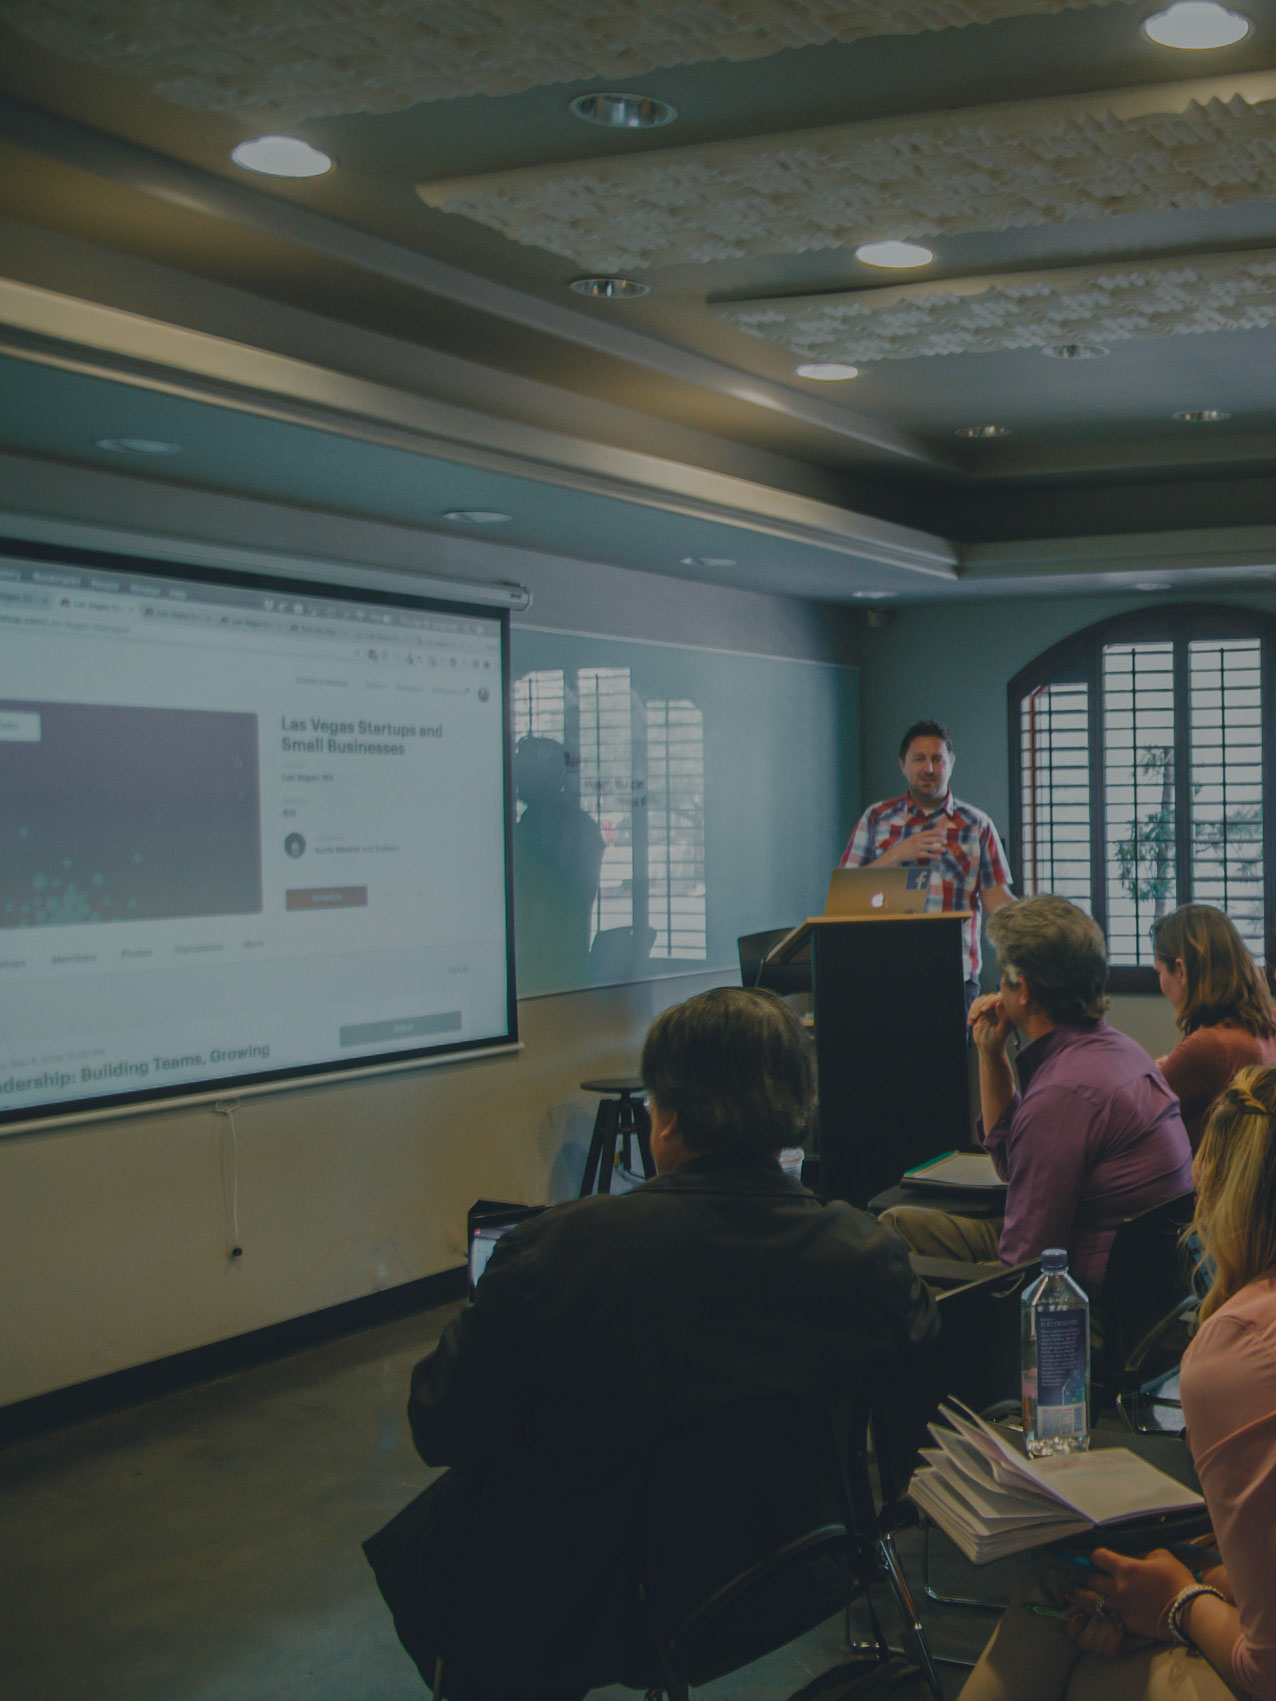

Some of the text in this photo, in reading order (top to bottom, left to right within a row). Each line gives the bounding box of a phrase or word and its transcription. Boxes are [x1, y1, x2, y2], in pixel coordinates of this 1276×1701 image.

[282, 716, 443, 740] Las Vegas Startups and
[282, 736, 405, 756] Small Businesses
[0, 1045, 271, 1095] dership: Building Teams, Growing
